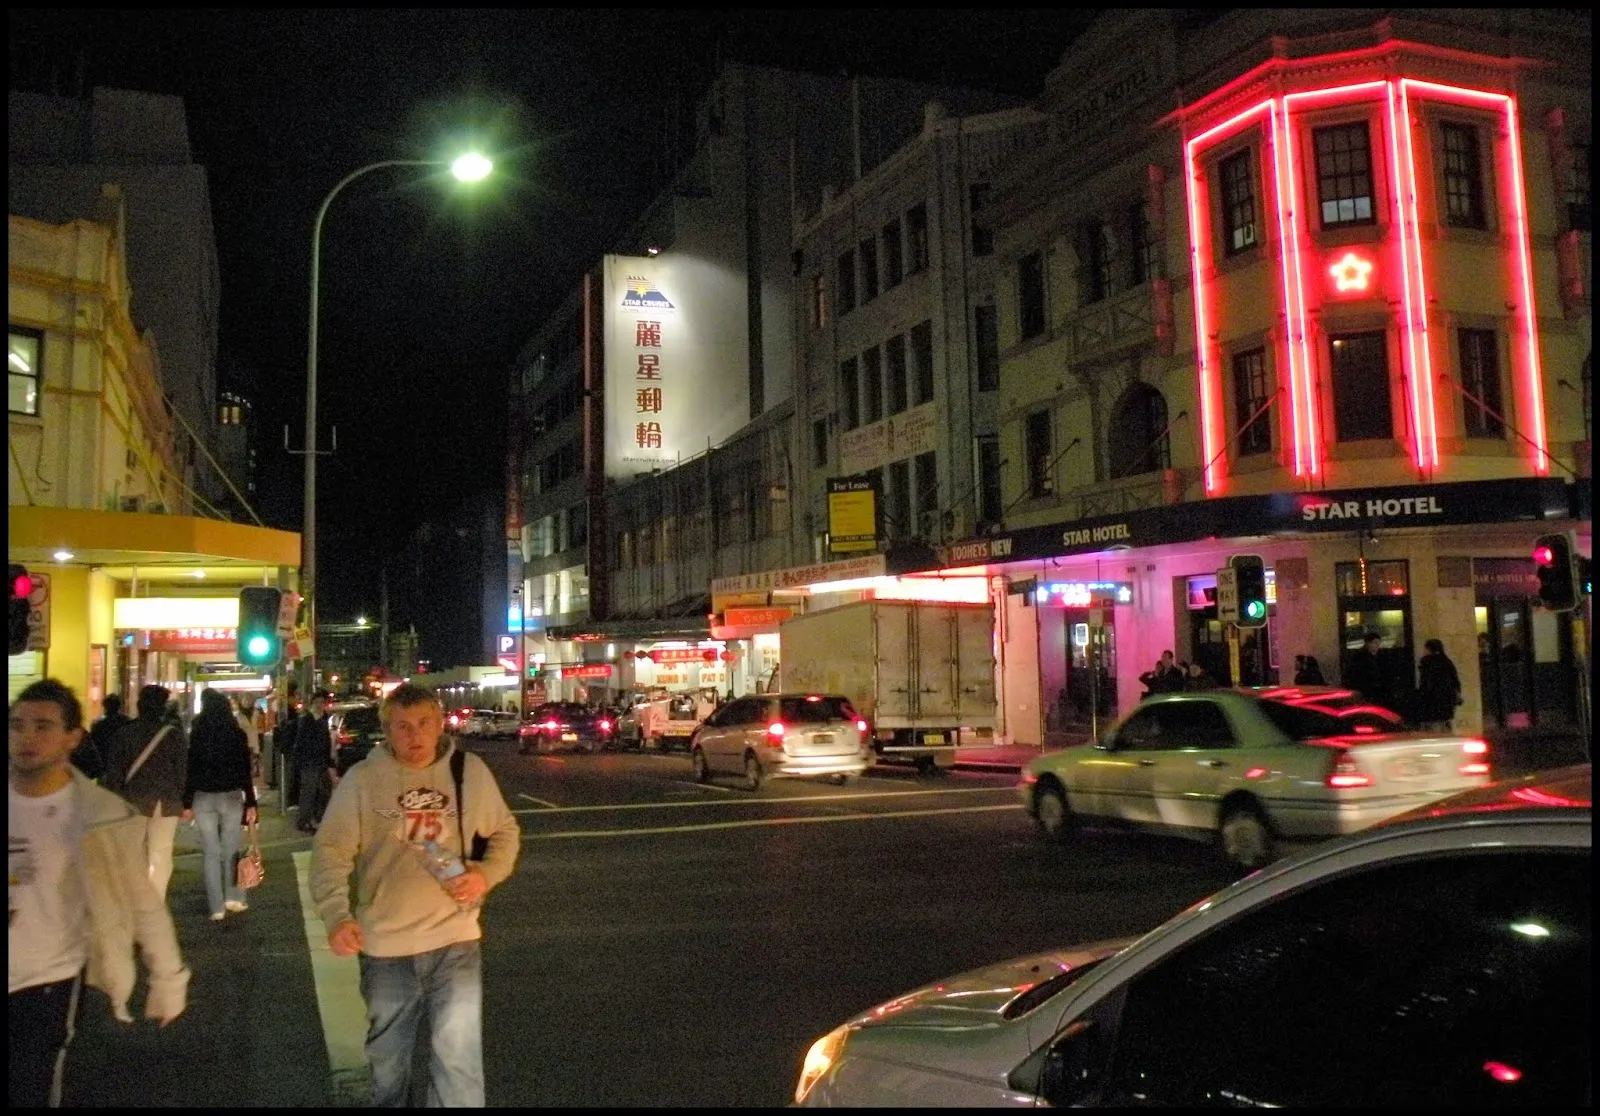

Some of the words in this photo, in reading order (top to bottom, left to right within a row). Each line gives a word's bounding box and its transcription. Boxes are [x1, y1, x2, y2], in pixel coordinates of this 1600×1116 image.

[624, 299, 641, 307] STAR
[642, 300, 669, 309] CRUISES
[635, 320, 662, 449] 麗星郵輪
[833, 482, 847, 491] For
[848, 481, 870, 490] Lease
[1302, 501, 1360, 521] STAR
[1366, 496, 1443, 517] HOTEL
[1063, 528, 1091, 546] STAR
[1092, 523, 1131, 542] HOTEL
[952, 543, 987, 560] TOOHEYS
[990, 538, 1013, 556] NEW
[1219, 572, 1233, 585] ONE
[501, 636, 515, 652] P
[405, 812, 443, 841] 75
